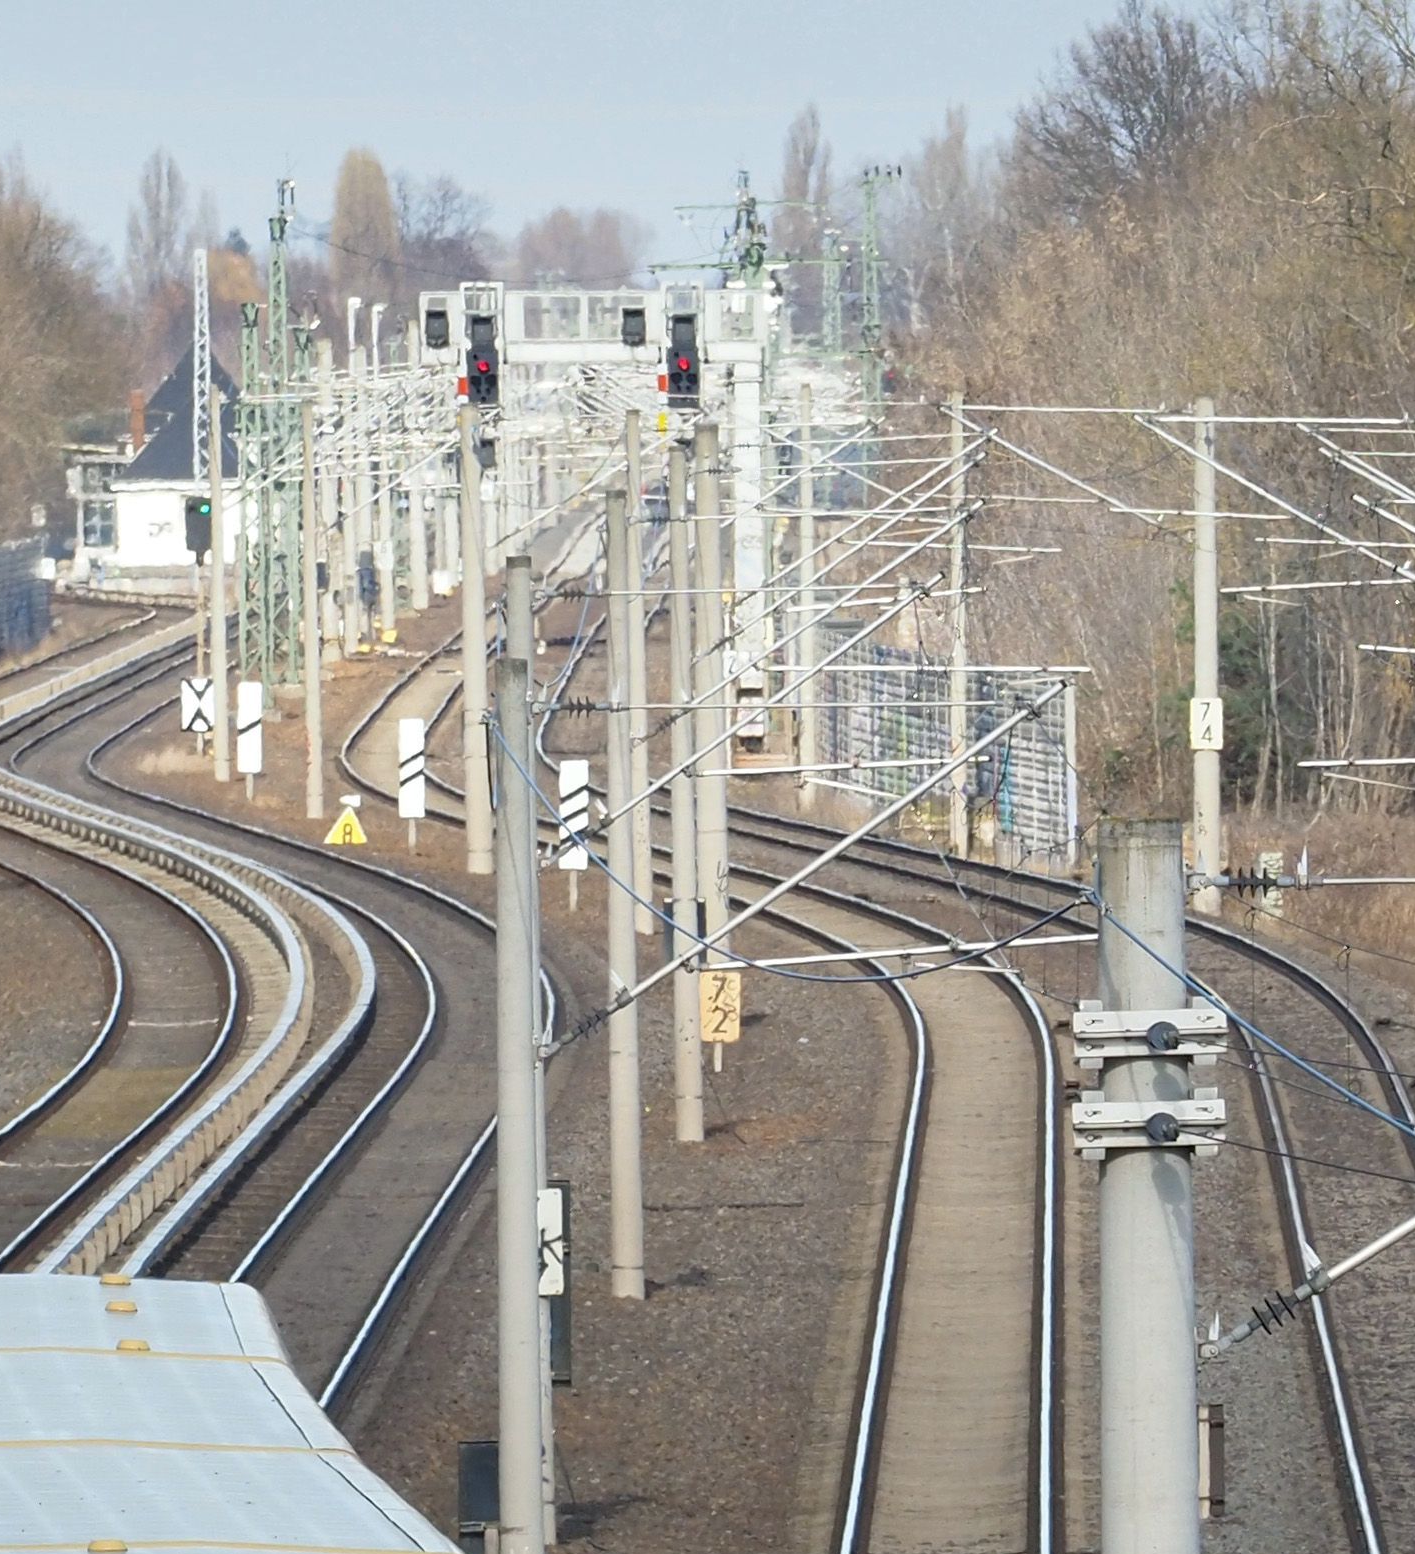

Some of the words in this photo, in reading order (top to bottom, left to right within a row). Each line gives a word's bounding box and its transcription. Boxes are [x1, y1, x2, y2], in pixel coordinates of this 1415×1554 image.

[1199, 702, 1211, 721] 7
[1201, 725, 1213, 743] 4
[712, 975, 727, 1003] 7
[711, 1005, 727, 1033] 2
